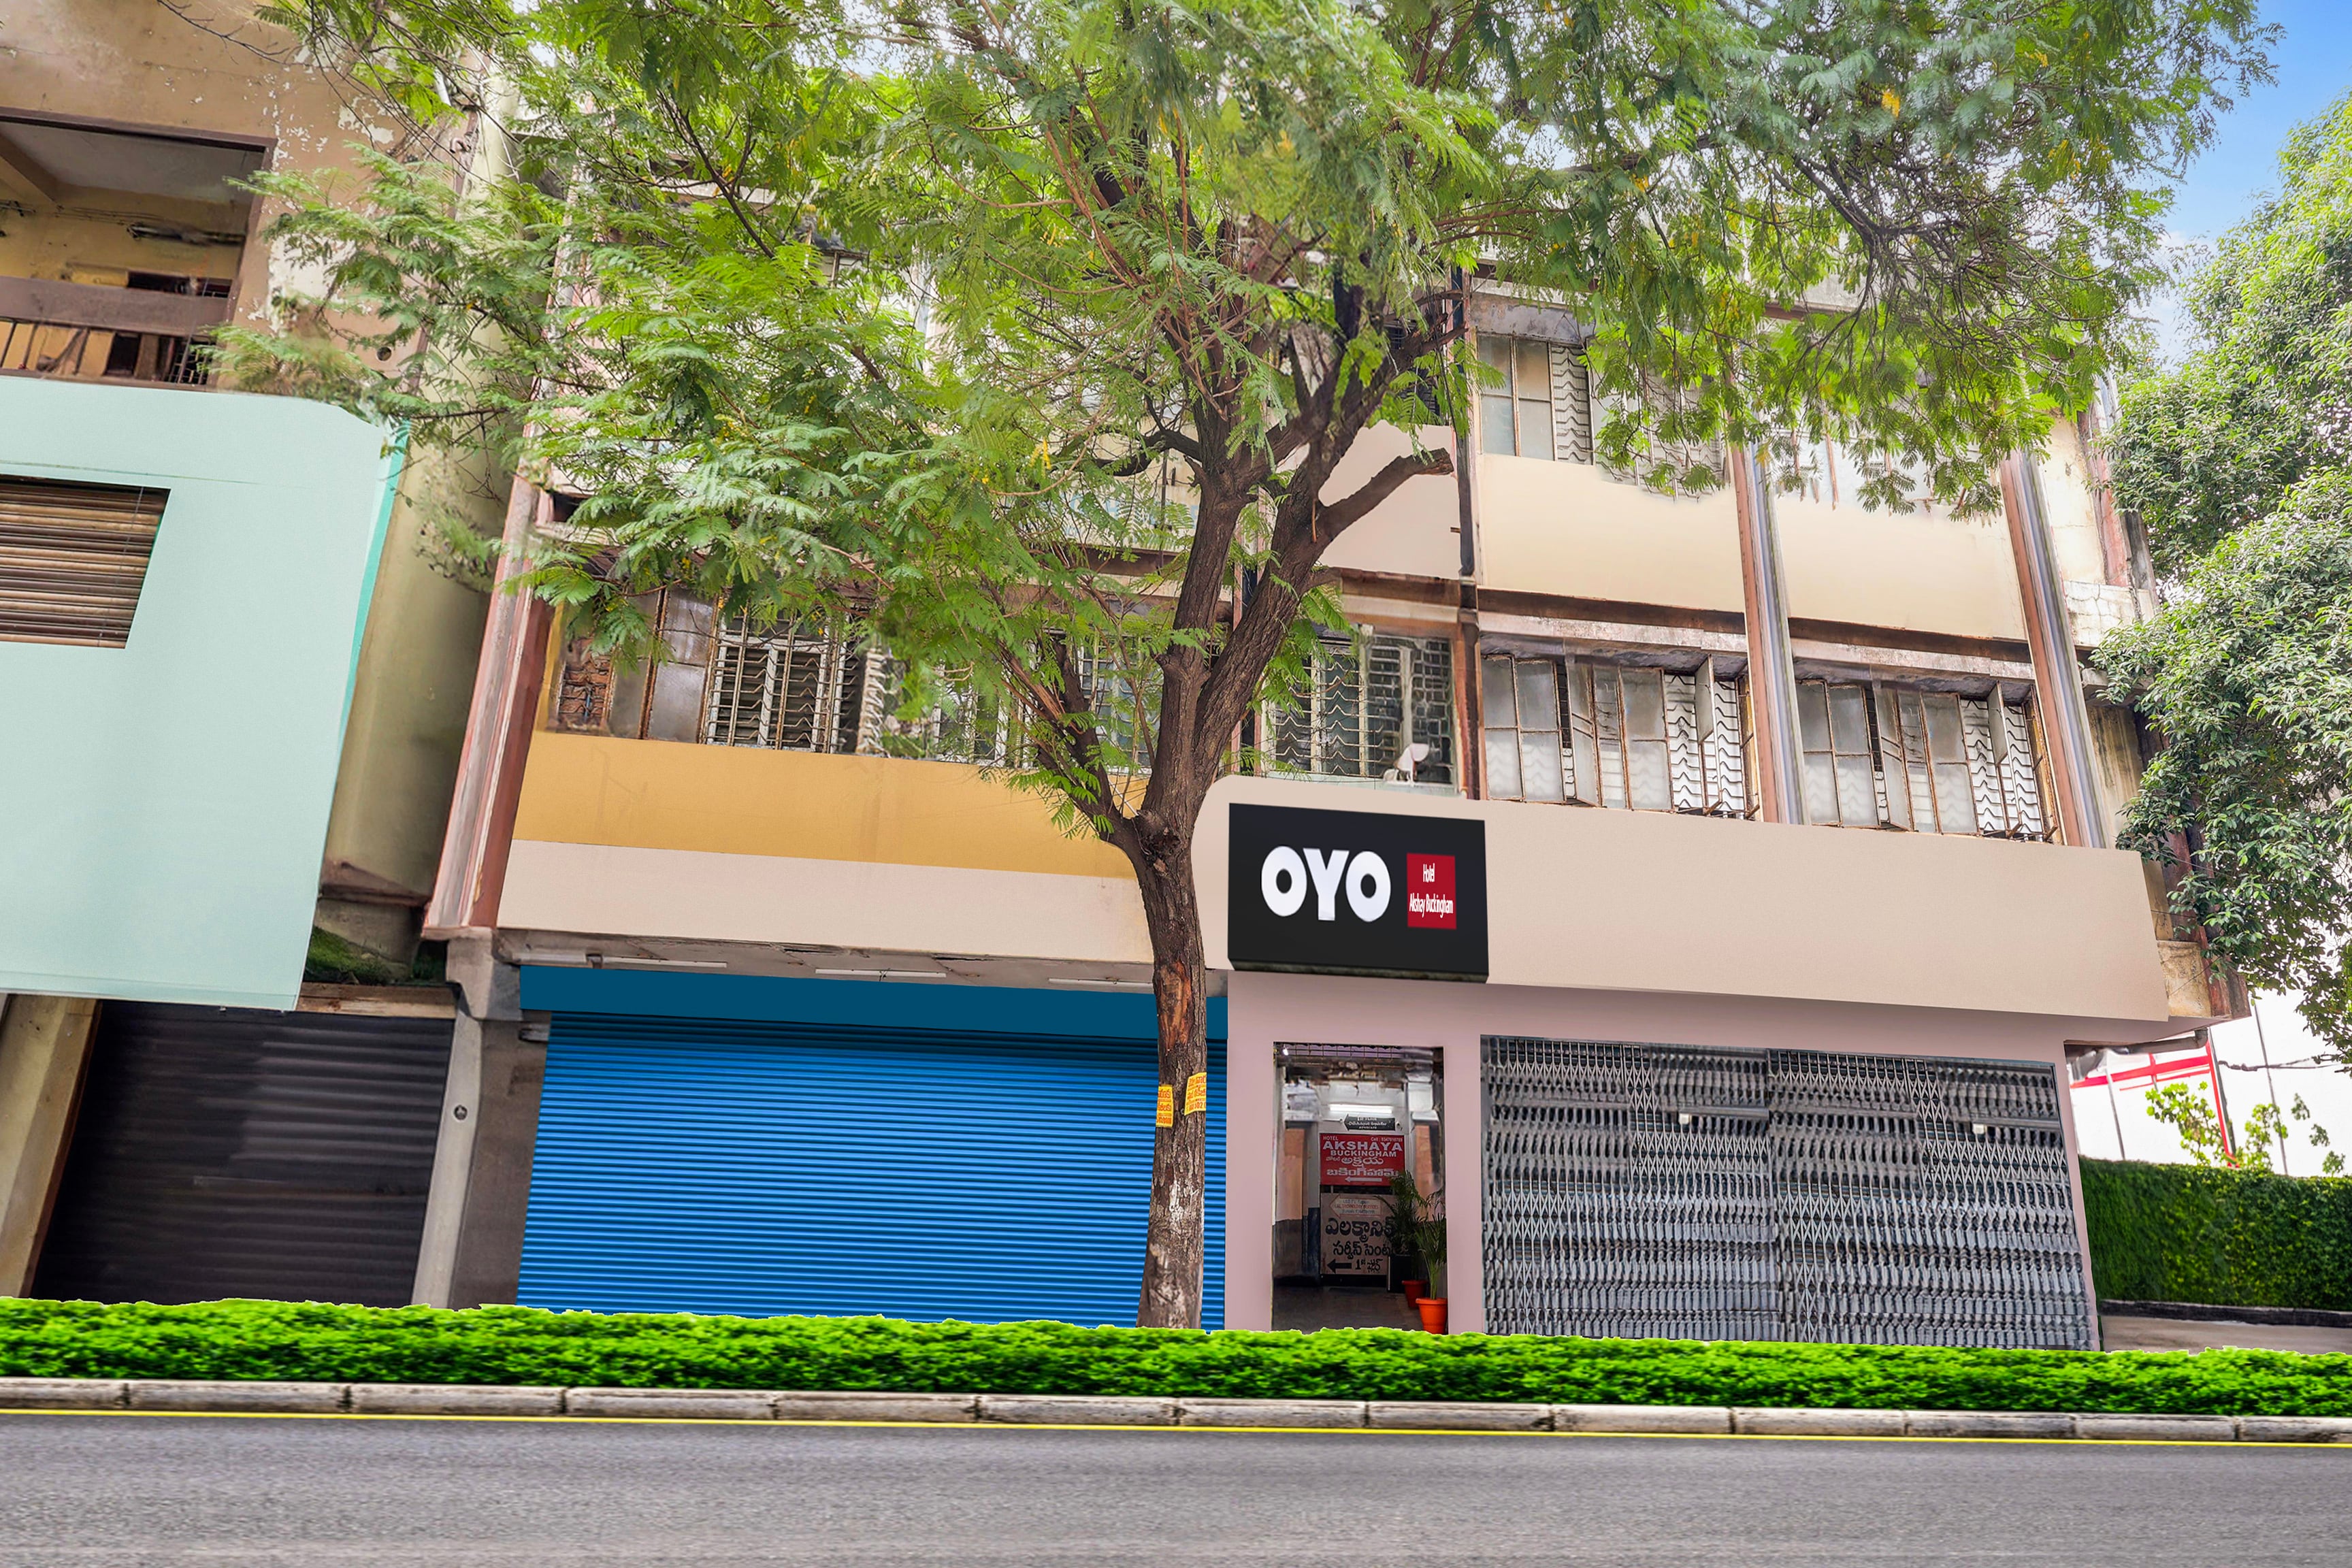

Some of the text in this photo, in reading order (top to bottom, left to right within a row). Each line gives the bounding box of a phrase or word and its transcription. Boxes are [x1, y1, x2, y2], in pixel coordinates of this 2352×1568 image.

[1261, 845, 1391, 922] OYO
[1423, 862, 1435, 883] Hotel
[1409, 892, 1454, 918] Akshay Buckingham
[1322, 1141, 1403, 1151] AKSHAYA
